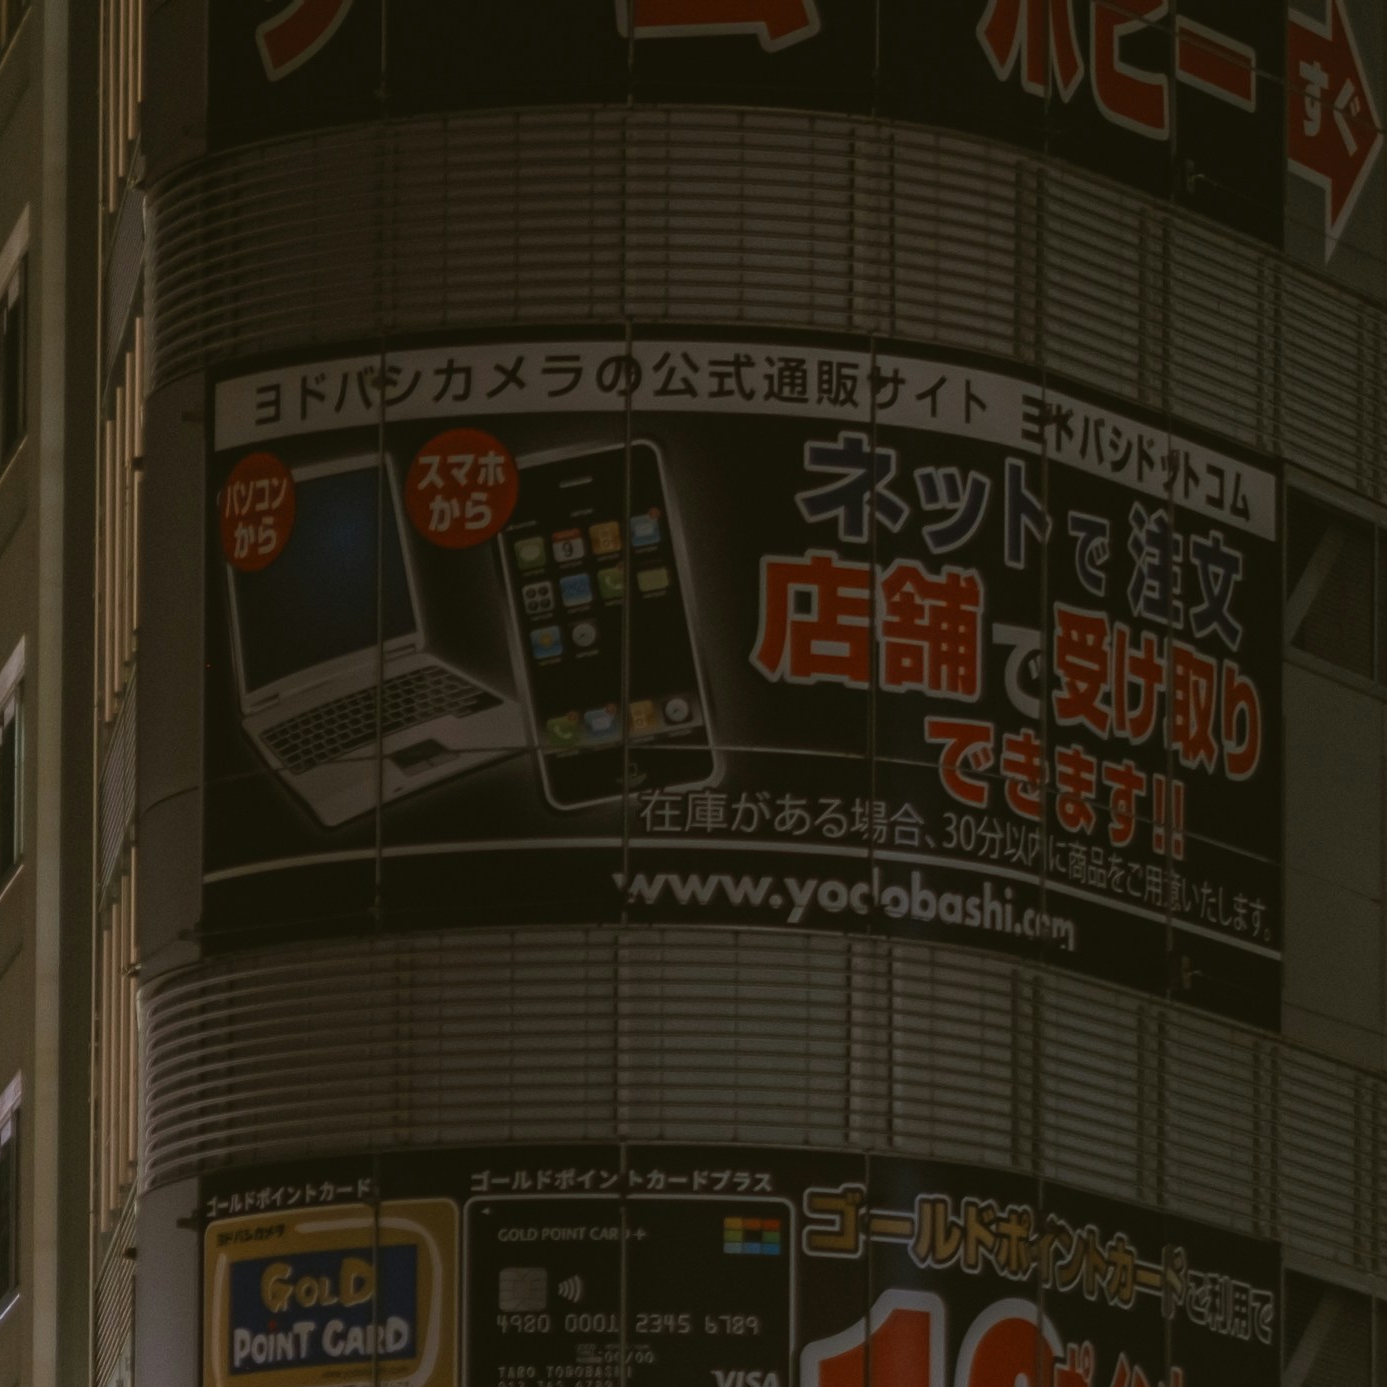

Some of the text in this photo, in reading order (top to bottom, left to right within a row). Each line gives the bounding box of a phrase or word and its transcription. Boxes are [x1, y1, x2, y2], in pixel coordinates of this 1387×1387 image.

[1299, 59, 1360, 157] すぐ
[256, 352, 987, 426] ヨドバシカメラの公式通販サイト
[417, 450, 506, 492] スマホ
[226, 477, 288, 517] パソコン
[429, 491, 493, 533] から
[233, 515, 278, 560] から
[794, 430, 1244, 653] ネットで注文
[755, 547, 1261, 783] 店舗で受け取り
[206, 1177, 374, 1218] ゴールドポイントカード
[470, 1168, 774, 1193] ゴールドポイントカードプラス
[497, 1227, 538, 1242] GOLD
[541, 1226, 586, 1242] POINT
[260, 1256, 376, 1314] GOLD
[321, 1315, 411, 1358] CARD
[634, 1313, 693, 1335] 2345
[703, 1313, 761, 1335] 6789
